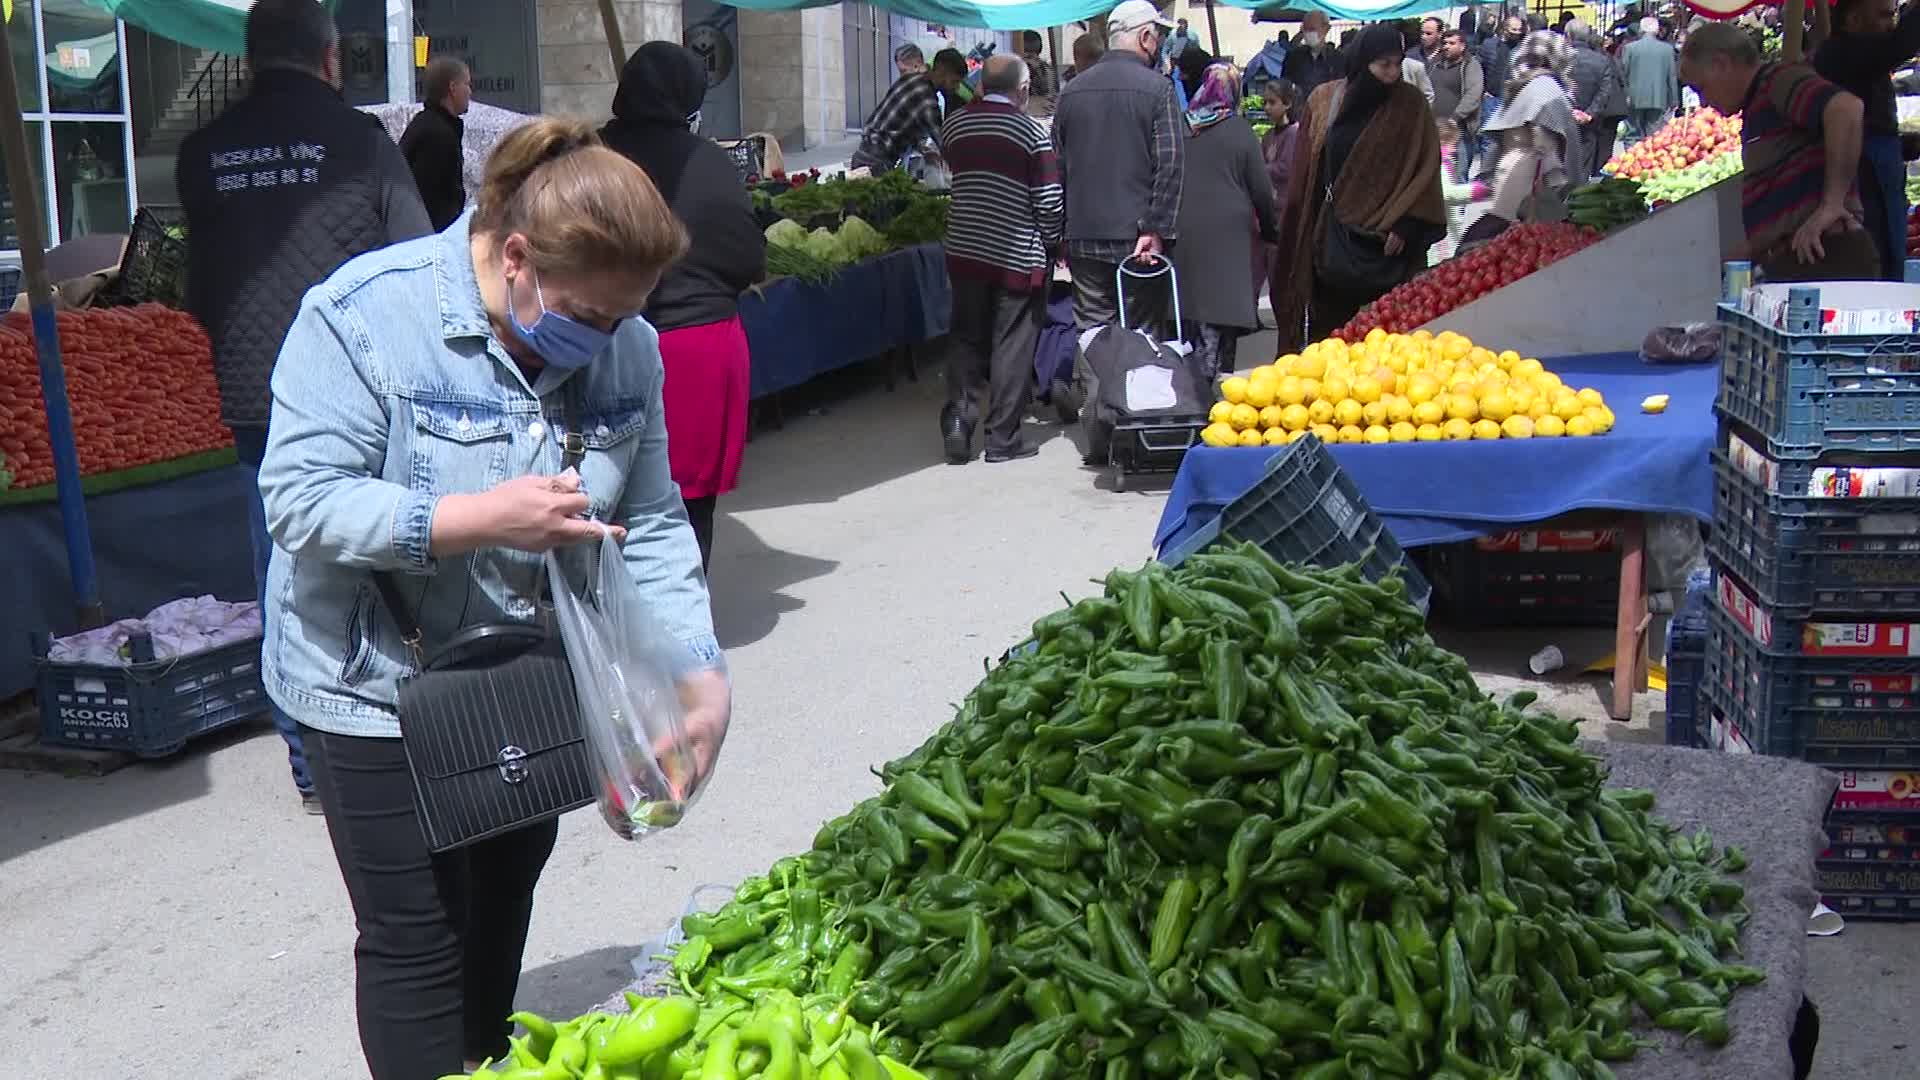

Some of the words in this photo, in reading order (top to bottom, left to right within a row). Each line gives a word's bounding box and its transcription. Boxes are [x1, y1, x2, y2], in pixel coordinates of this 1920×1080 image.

[216, 175, 249, 192] 0505
[252, 170, 278, 186] 055
[281, 167, 298, 183] 80
[303, 167, 319, 183] 51
[113, 712, 129, 728] 63
